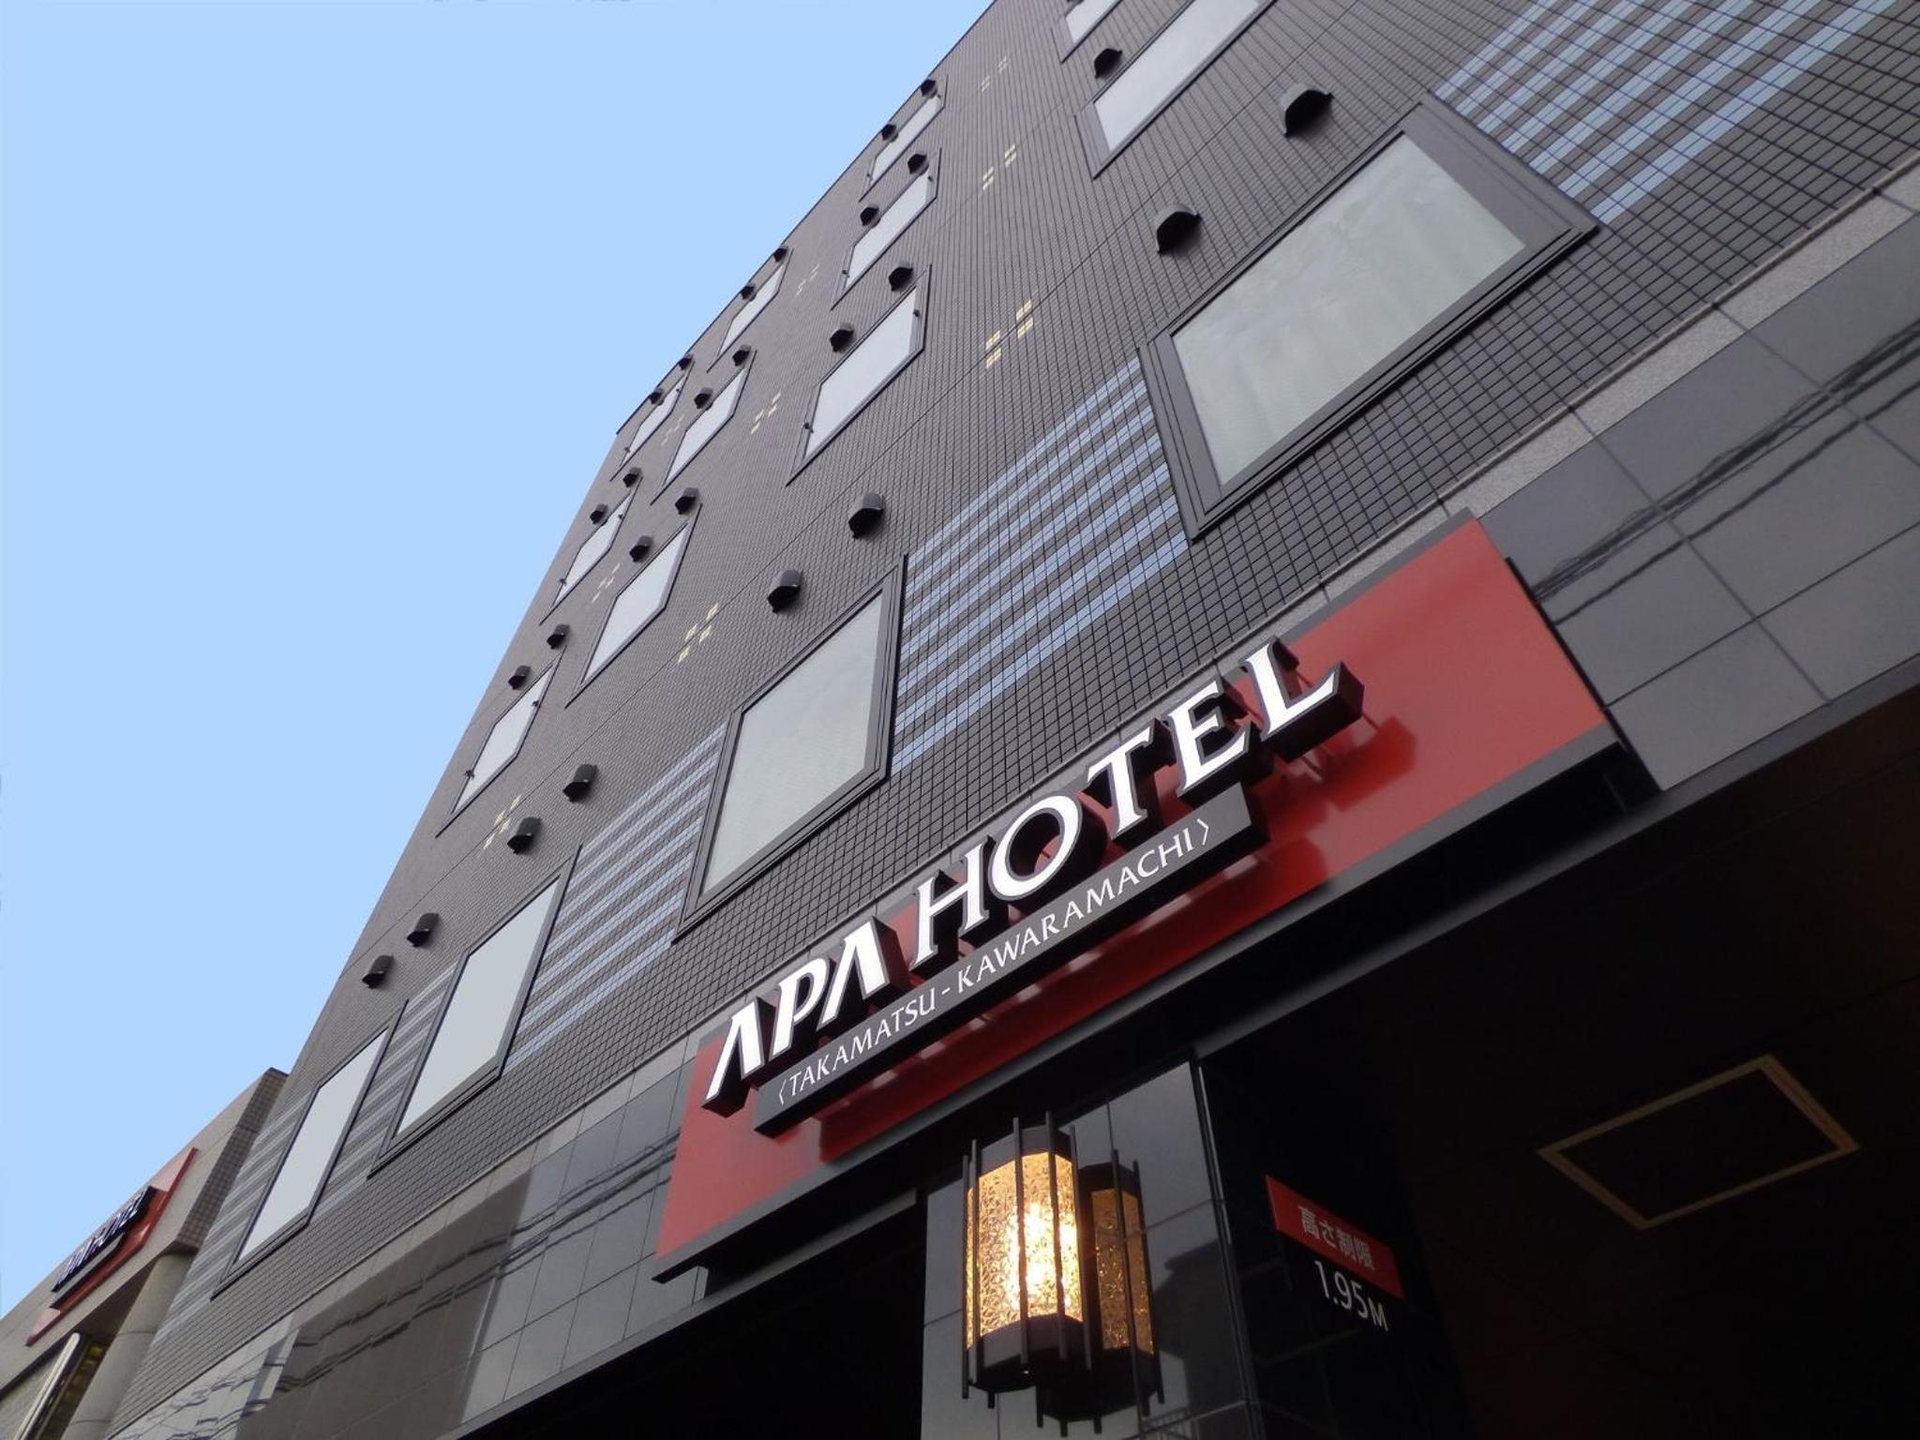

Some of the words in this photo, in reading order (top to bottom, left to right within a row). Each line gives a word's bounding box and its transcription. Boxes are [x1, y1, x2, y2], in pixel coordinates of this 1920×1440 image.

[704, 921, 890, 1101] APA
[911, 640, 1340, 968] HOTEL
[1315, 1261, 1389, 1332] 1.95M
